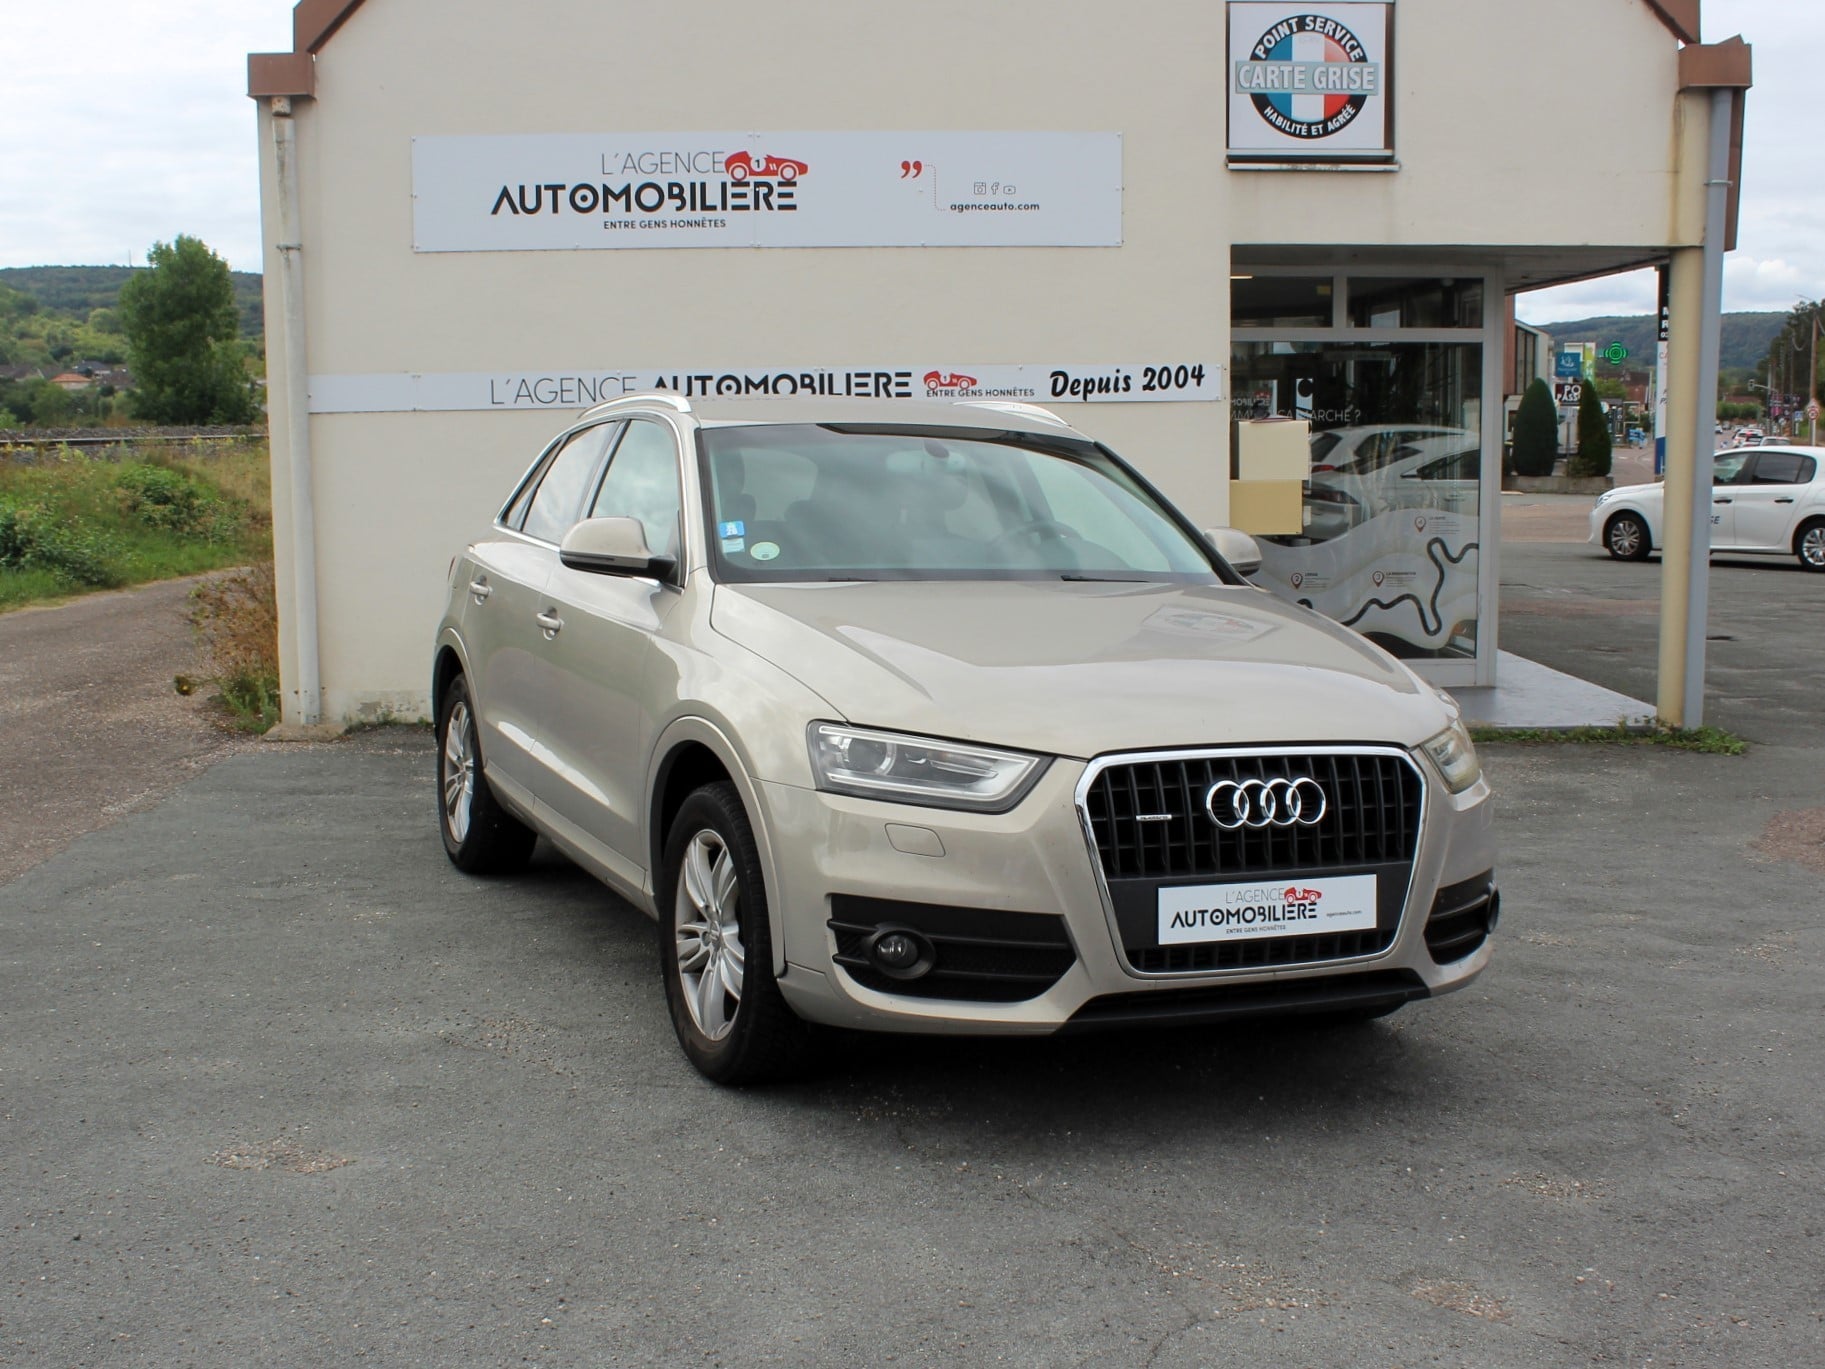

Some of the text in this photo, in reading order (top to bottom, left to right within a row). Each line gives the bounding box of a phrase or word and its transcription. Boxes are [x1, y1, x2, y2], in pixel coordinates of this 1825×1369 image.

[1255, 16, 1363, 62] POINT SERVICE
[1239, 65, 1374, 90] CARTE GRISE
[1264, 104, 1356, 136] HABILITÉ ET AGRÉÉ
[601, 151, 725, 175] L'AGENCE
[949, 202, 1040, 213] agenceauto.com
[604, 216, 726, 229] ENTRE GENS HONNÊTES
[490, 376, 637, 404] L'AGENCE
[926, 386, 1035, 397] ENTRE GENS HONNÊTES
[1049, 364, 1205, 402] Depuis 2004
[1225, 888, 1284, 904] L'AGENCE
